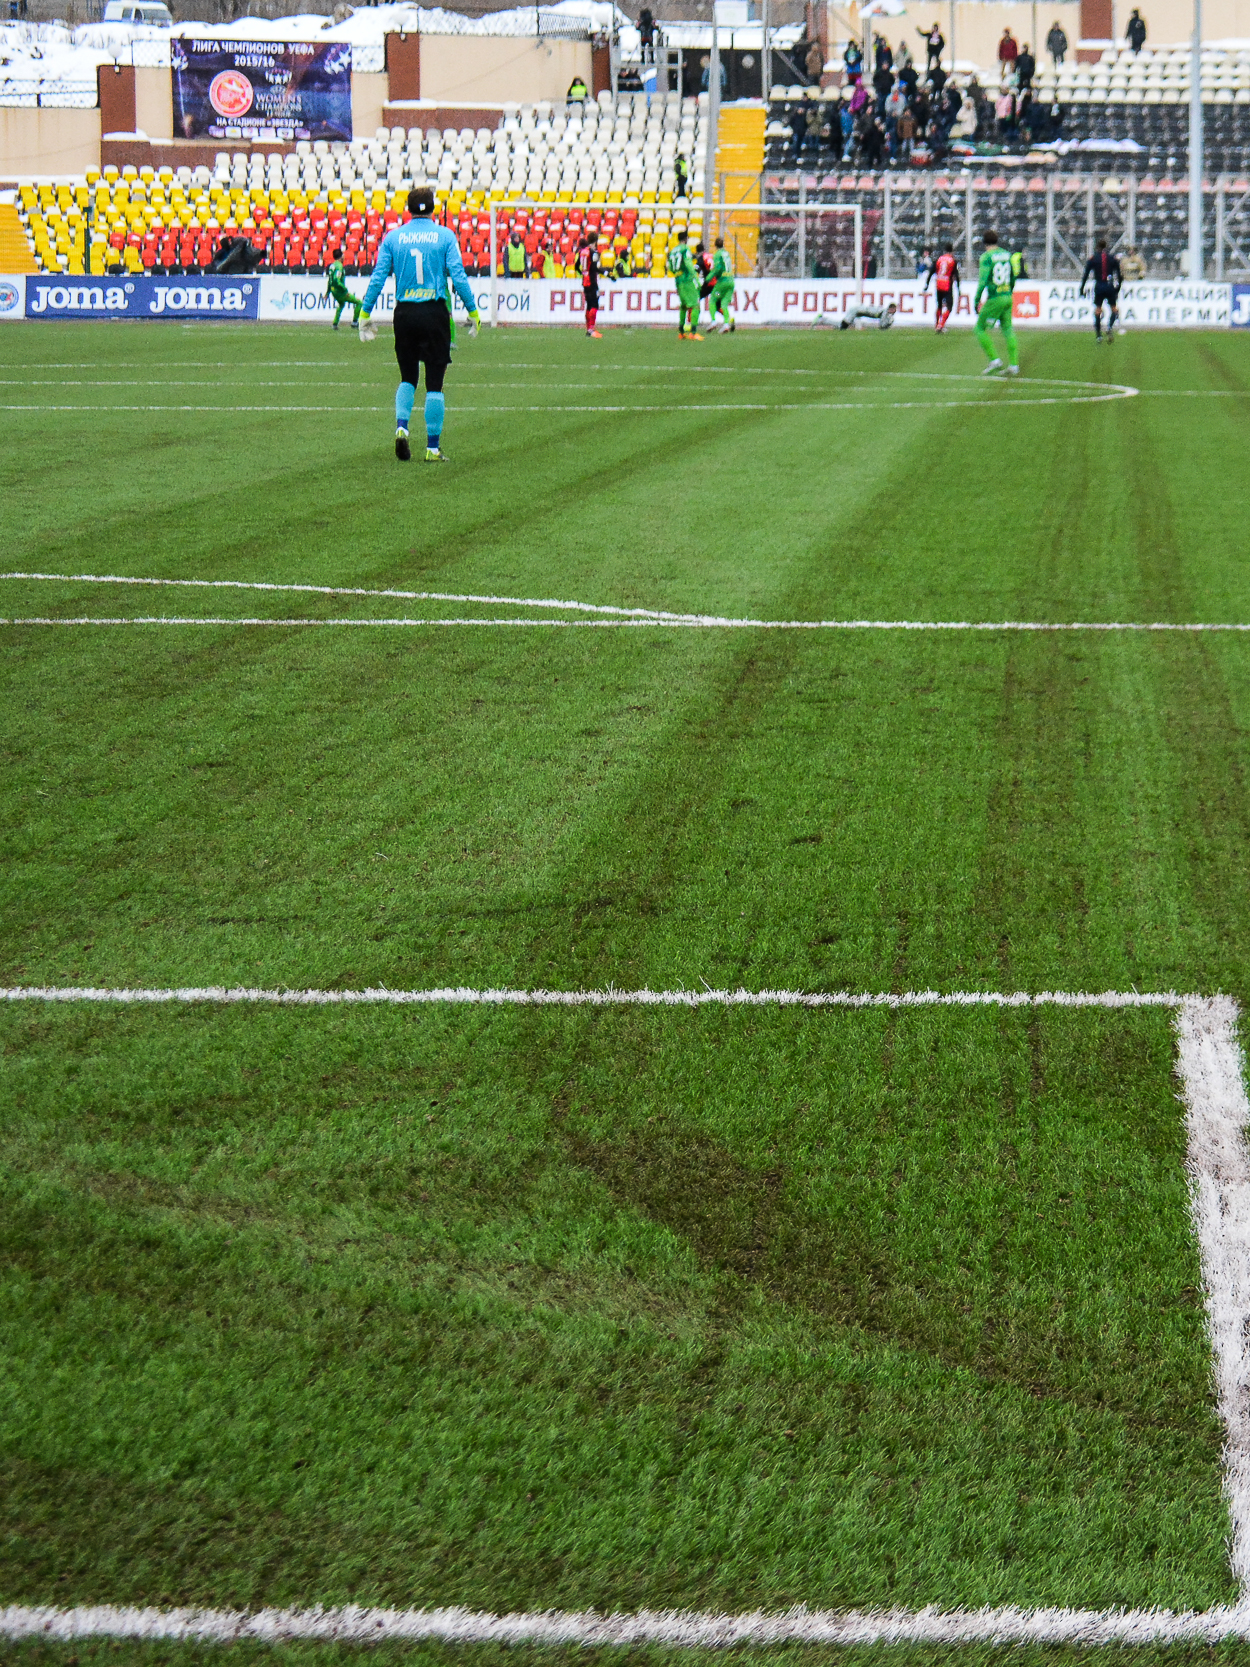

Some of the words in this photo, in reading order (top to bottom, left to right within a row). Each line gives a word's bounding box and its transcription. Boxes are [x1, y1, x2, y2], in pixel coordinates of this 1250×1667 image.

[192, 40, 220, 53] ЛИГА
[222, 41, 284, 54] ЧЕМПИОНОВ
[288, 43, 315, 55] УЕФА
[234, 54, 275, 67] 2015/16
[216, 117, 227, 126] НА
[228, 117, 266, 127] СТАДИОНЕ
[399, 231, 439, 244] РЫЖИКОВ
[410, 248, 424, 285] 1
[1150, 307, 1229, 322] ПЕРМИ
